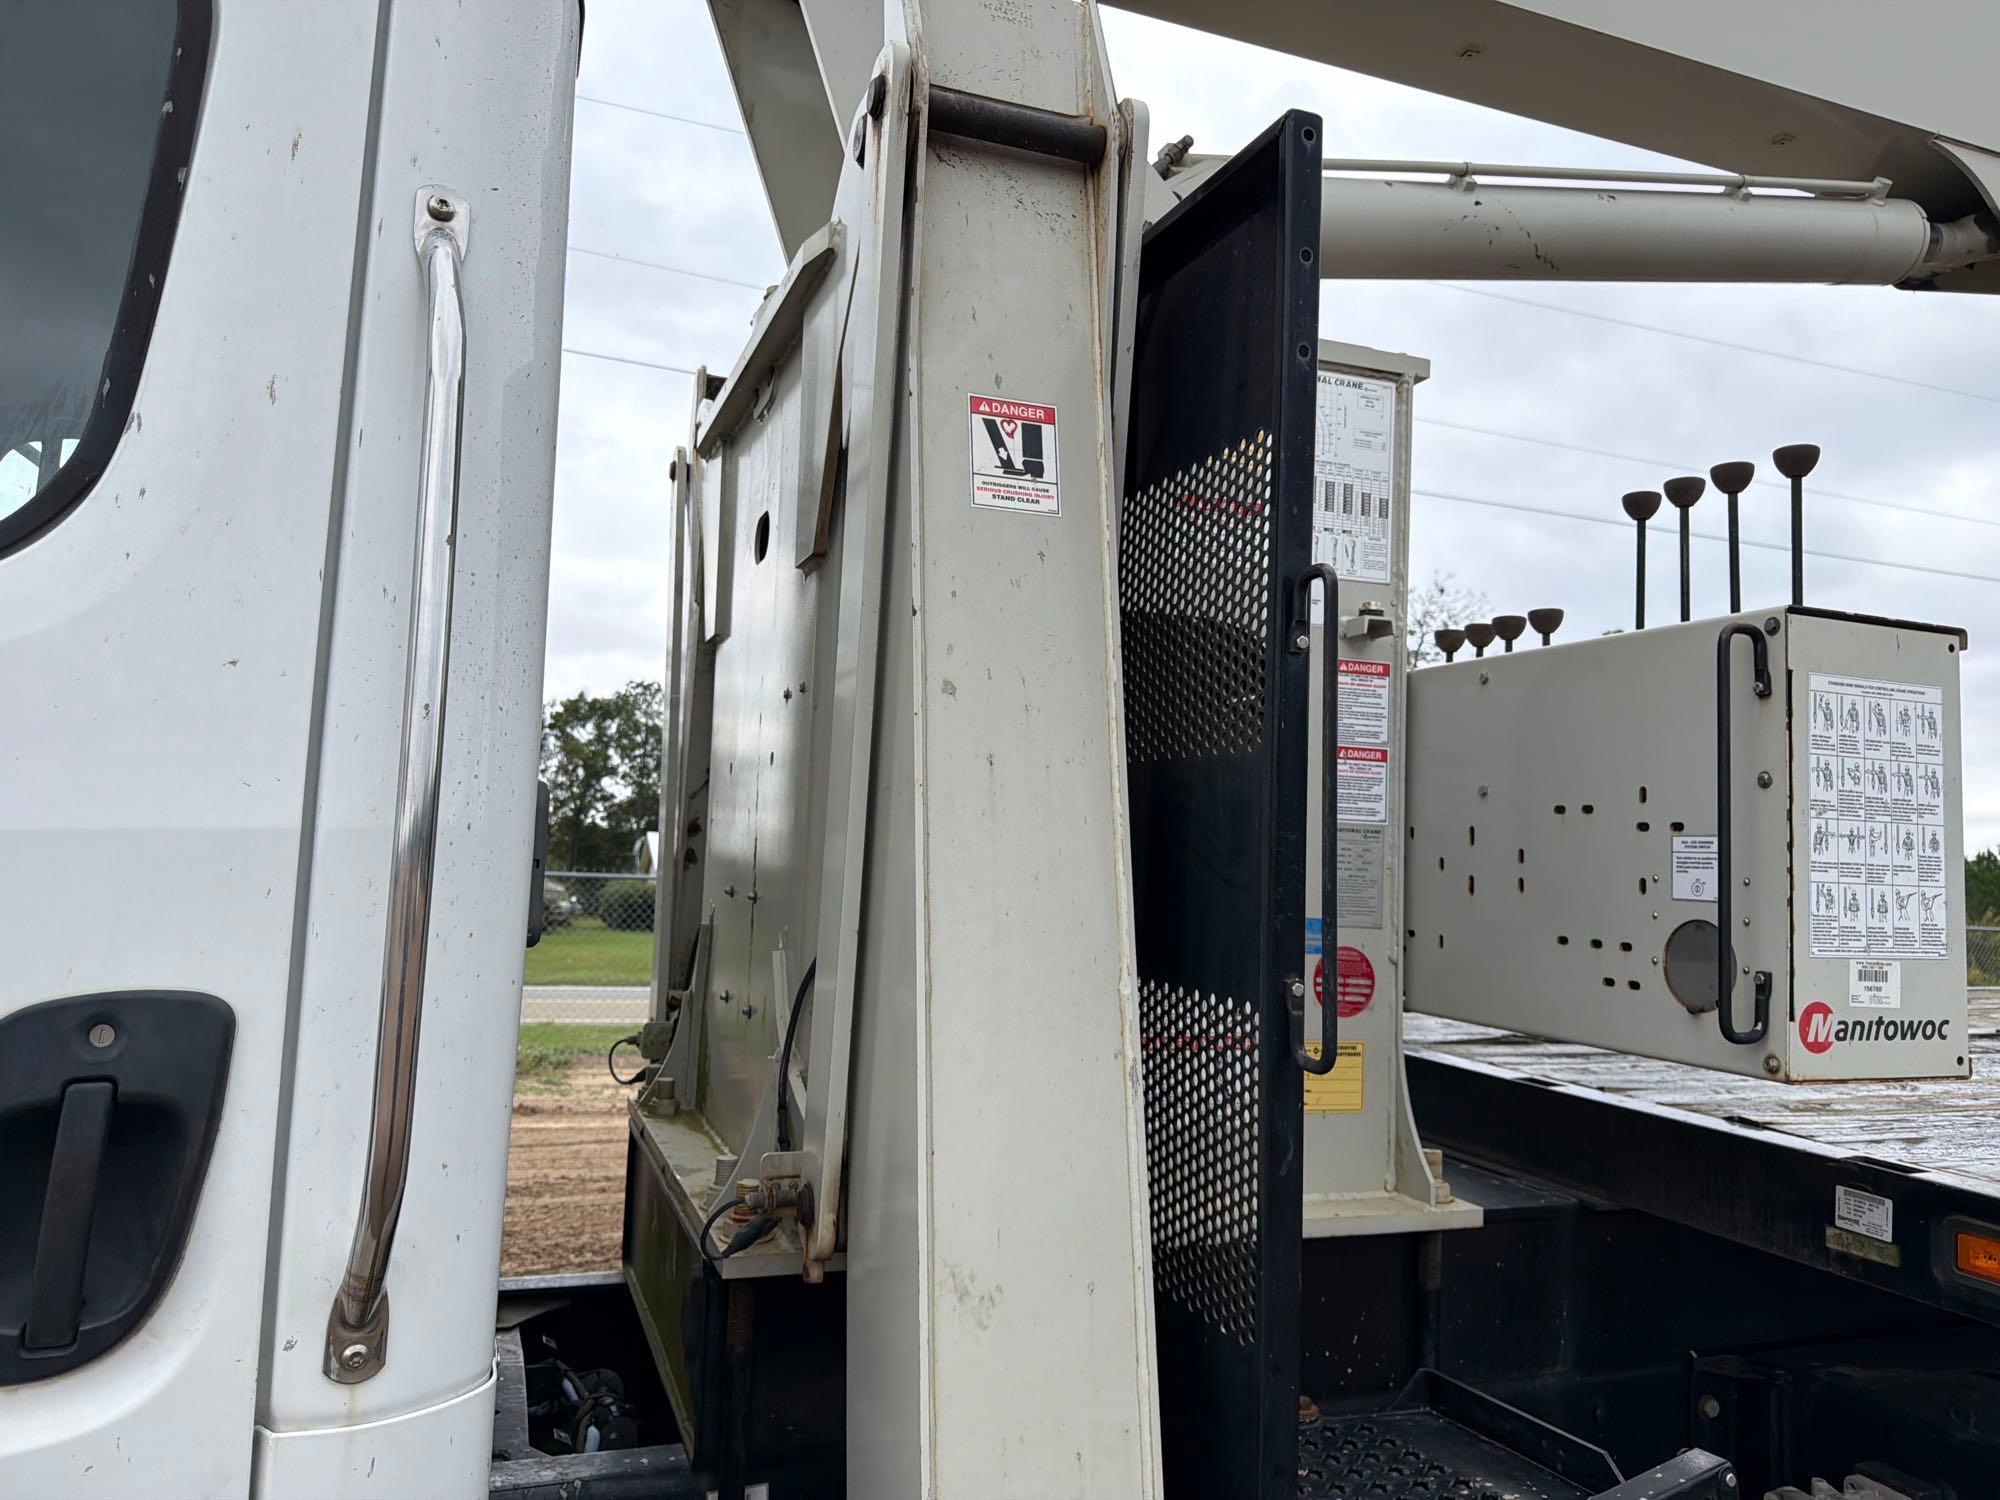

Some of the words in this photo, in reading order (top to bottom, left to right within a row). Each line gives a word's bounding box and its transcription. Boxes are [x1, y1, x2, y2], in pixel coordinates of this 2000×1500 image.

[1334, 379, 1364, 390] CRANE
[991, 402, 1045, 419] DANGER
[981, 480, 1017, 490] OUTRIGGERS
[976, 485, 1002, 494] SERIOUS
[1002, 489, 1033, 498] CRUSHING
[991, 493, 1016, 502] STAND
[1016, 496, 1041, 505] CLEAR
[1347, 663, 1384, 674] DANGER
[1347, 749, 1382, 760] DANGER
[1807, 1012, 1951, 1043] Manitowoc
